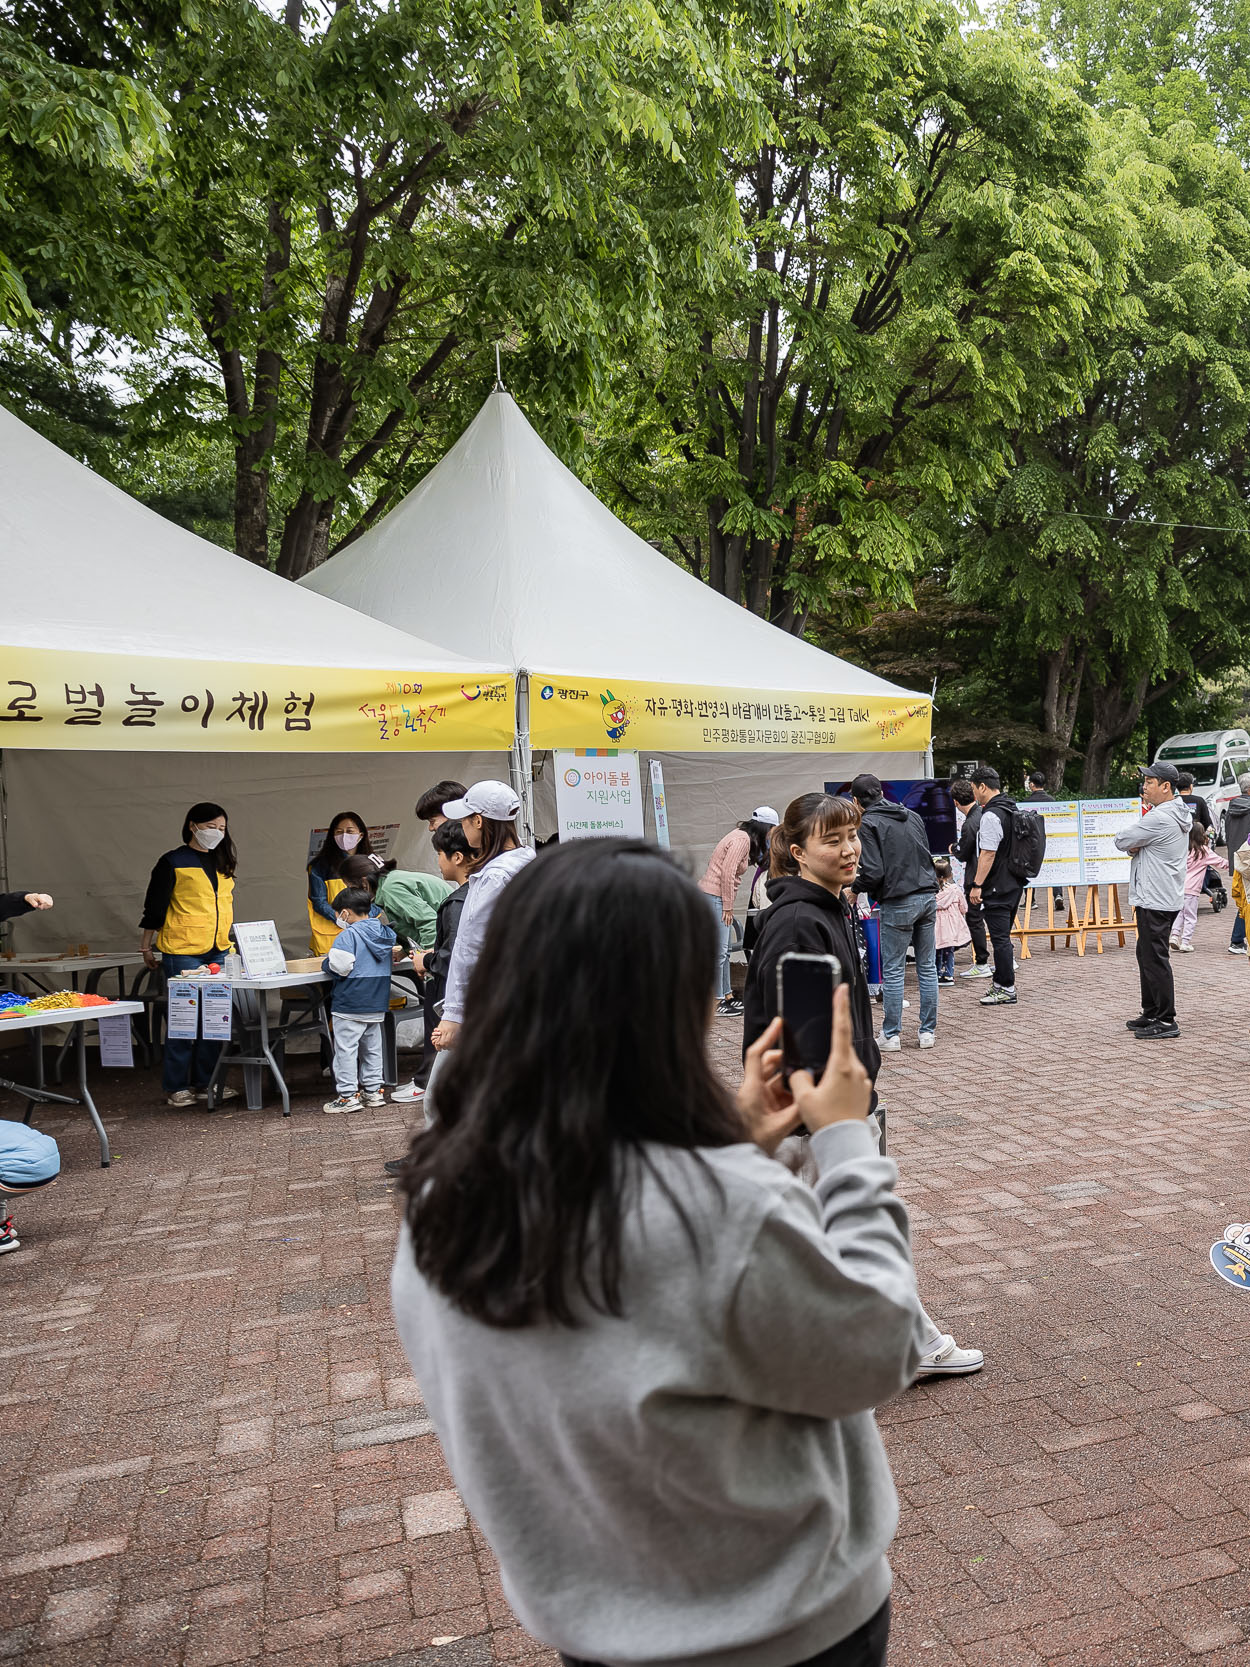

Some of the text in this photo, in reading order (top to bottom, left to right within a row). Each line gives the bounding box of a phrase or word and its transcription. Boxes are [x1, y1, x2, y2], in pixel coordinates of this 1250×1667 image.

[557, 688, 589, 700] 광진구
[0, 680, 316, 731] 로벌놀이체험
[645, 697, 730, 719] 자유·평화·번영의
[732, 703, 771, 721] 바람개비
[848, 708, 871, 723] Talk!
[703, 728, 837, 745] 민주평화통일자문회의 광진구협의회
[583, 771, 631, 787] 아이돌봄
[586, 790, 631, 805] 지원사업
